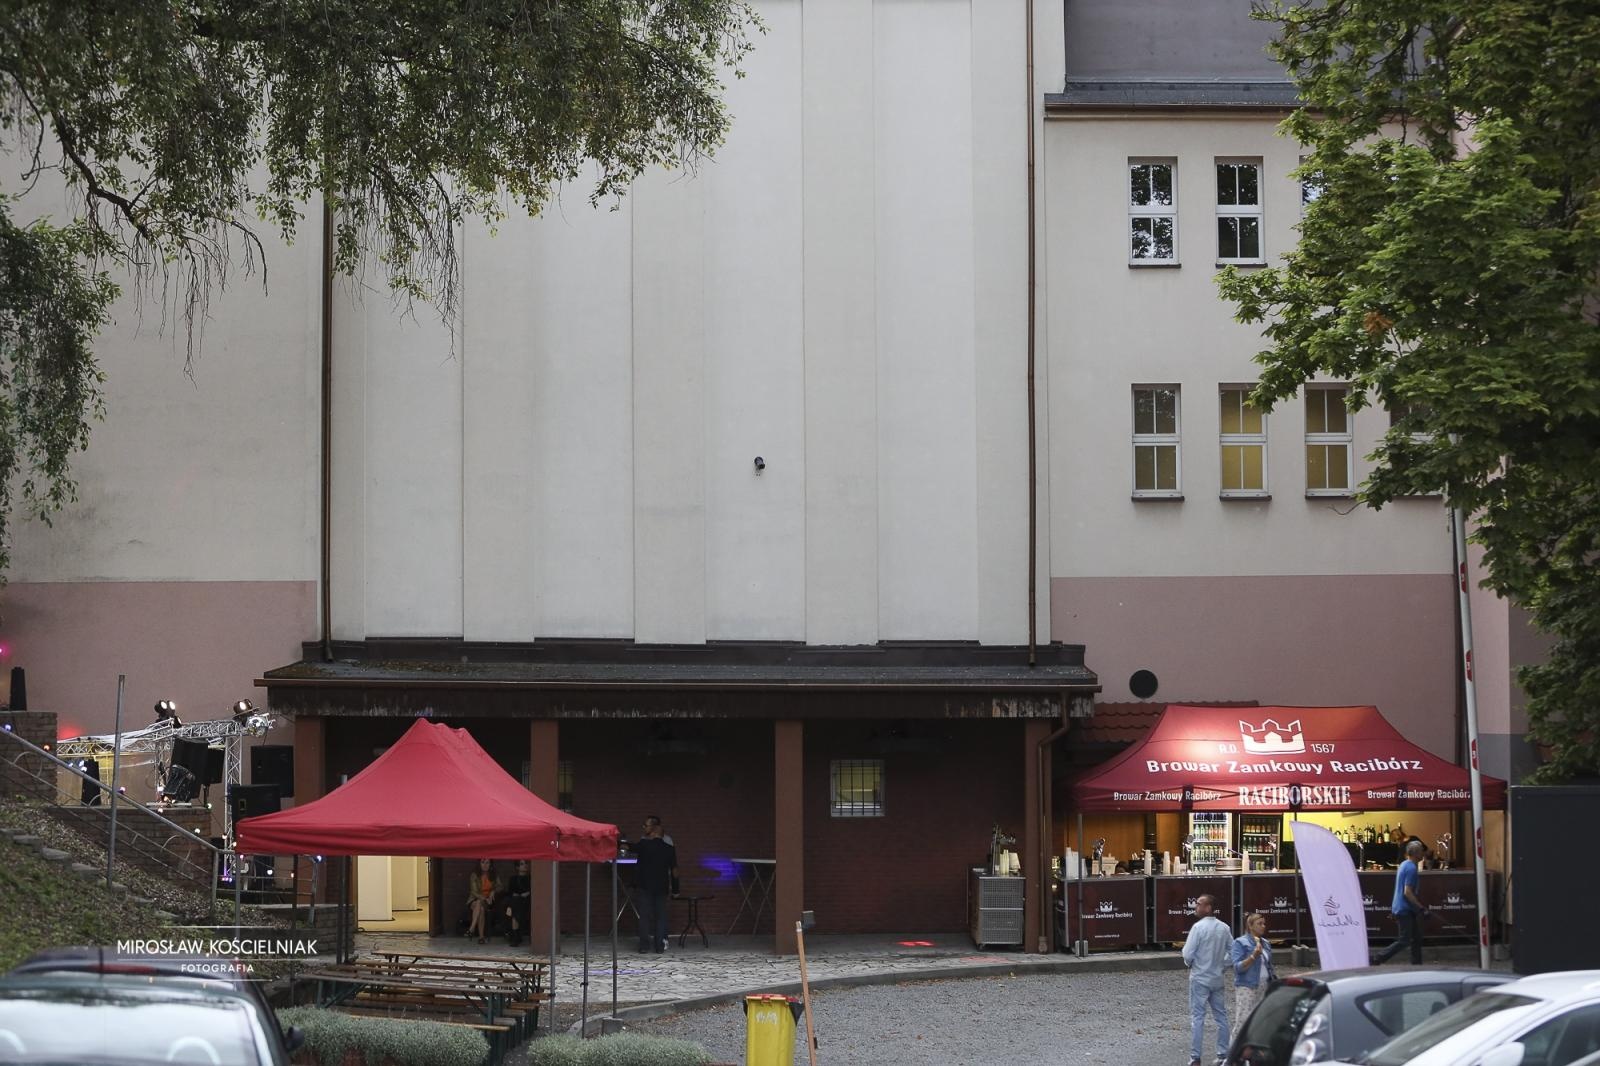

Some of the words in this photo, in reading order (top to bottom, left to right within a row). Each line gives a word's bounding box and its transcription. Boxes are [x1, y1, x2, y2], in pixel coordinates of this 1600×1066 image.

[1310, 743, 1335, 753] 1567
[1146, 760, 1219, 773] Browar
[1226, 759, 1323, 775] Zamkowy
[1329, 757, 1424, 773] Racibórz
[1113, 791, 1142, 801] Browar
[1145, 790, 1183, 802] Zamkowy
[1185, 790, 1222, 801] Racibórz
[1239, 785, 1351, 806] RACIBORSKIE
[1367, 789, 1396, 799] Browar
[1398, 789, 1435, 801] Zamkowy
